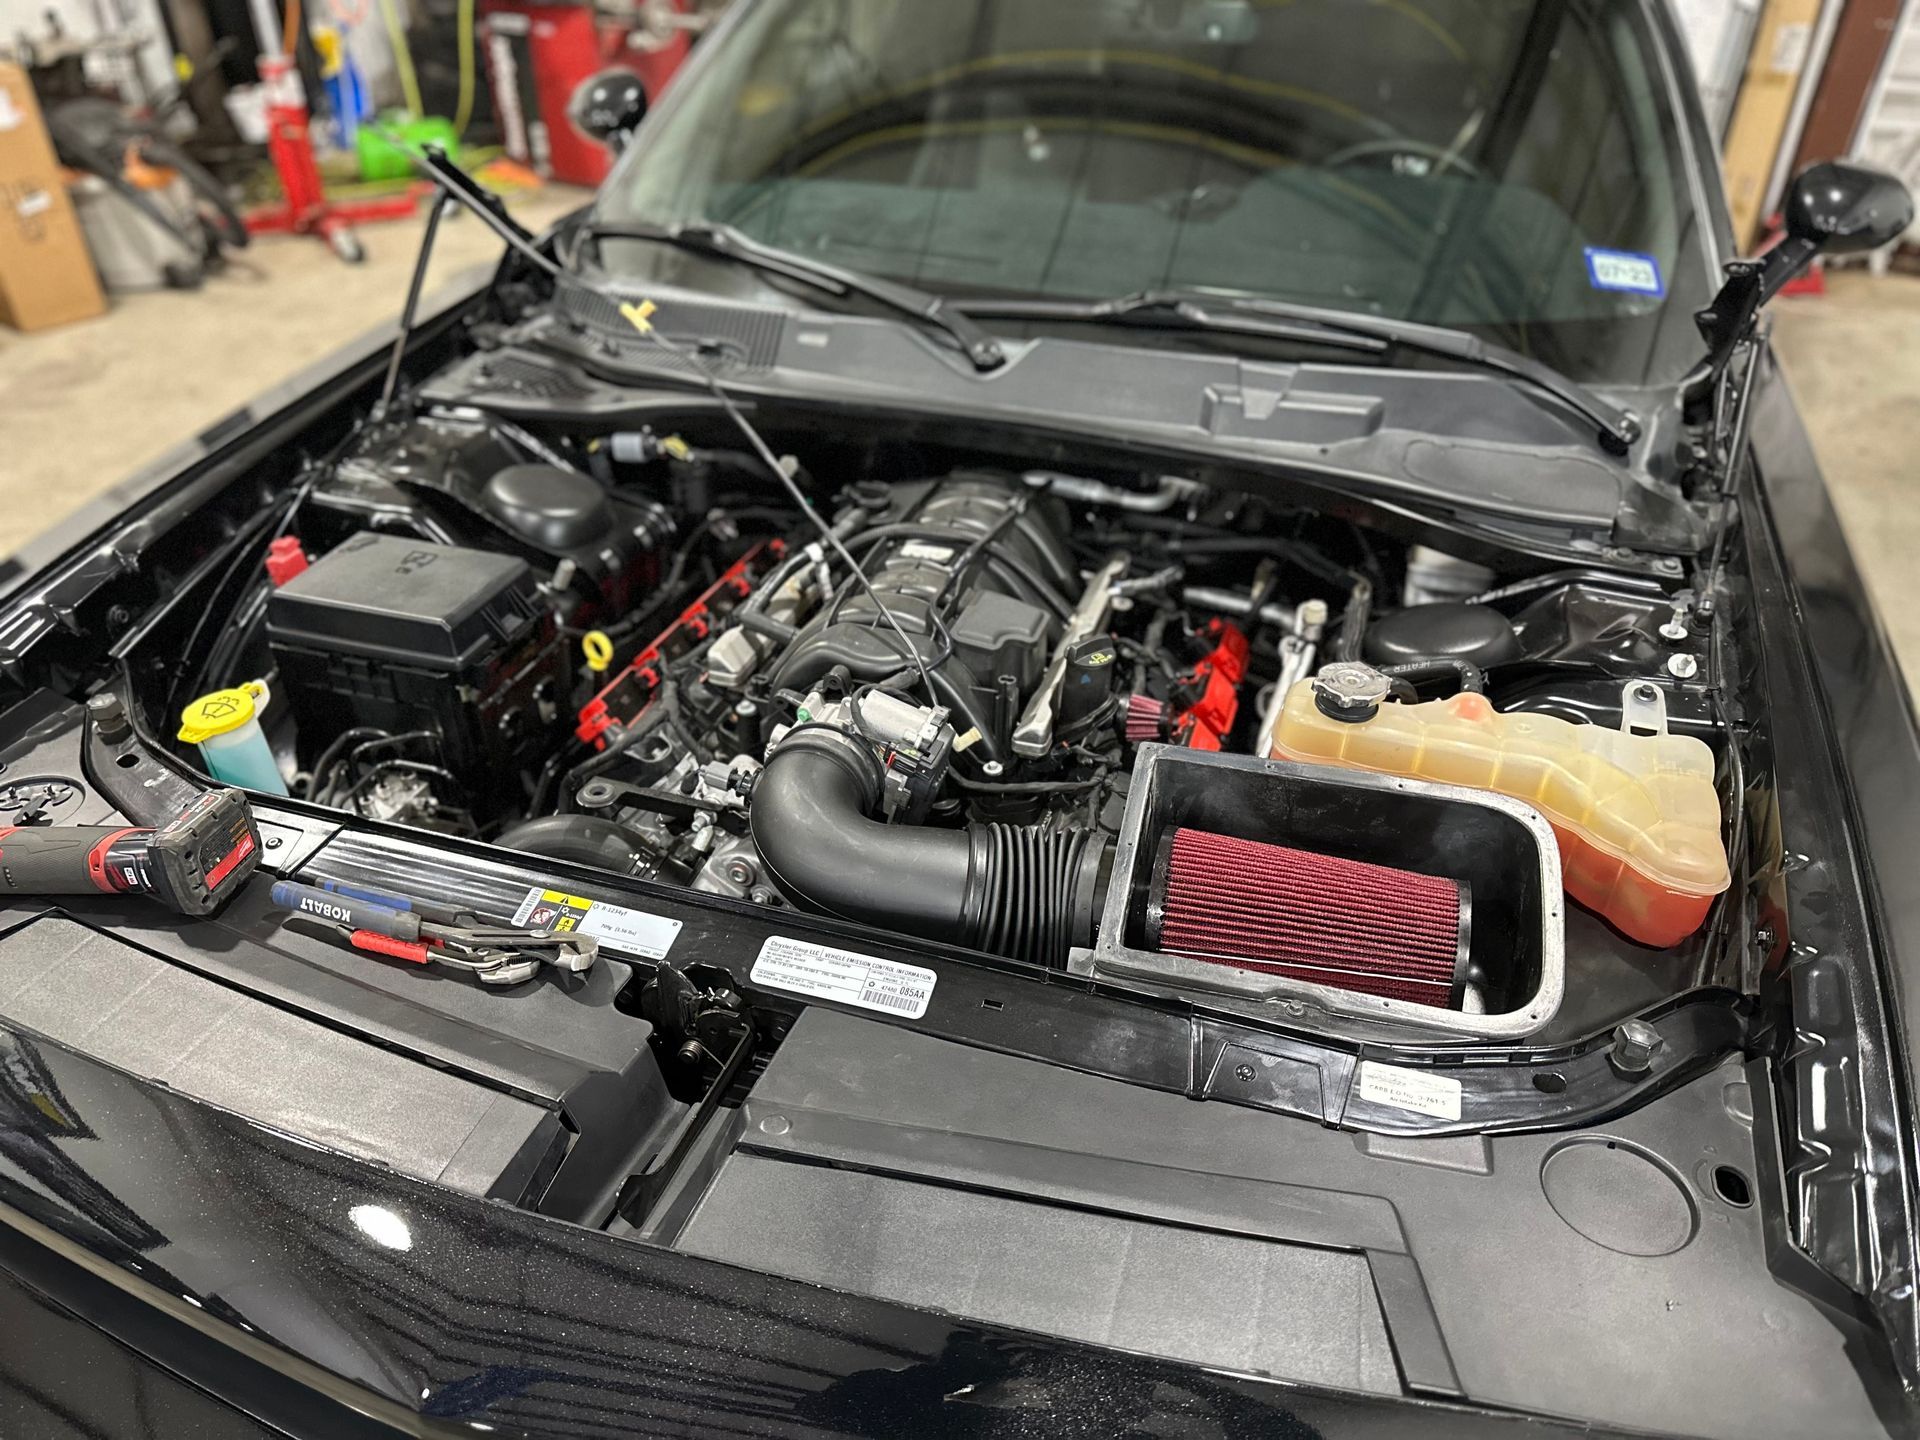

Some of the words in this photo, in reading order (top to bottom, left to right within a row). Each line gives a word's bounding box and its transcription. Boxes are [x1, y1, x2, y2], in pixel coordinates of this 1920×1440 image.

[1393, 661, 1431, 673] HEATER
[300, 897, 351, 923] KOBALT
[601, 906, 628, 917] R-1234yf
[771, 940, 792, 950] Chrysler
[792, 945, 808, 954] Group
[824, 952, 845, 961] VEHICLE
[846, 957, 871, 967] EMISSION
[871, 962, 894, 973] CONTROL
[896, 968, 932, 980] INFORMATION
[899, 986, 925, 999] 085AA
